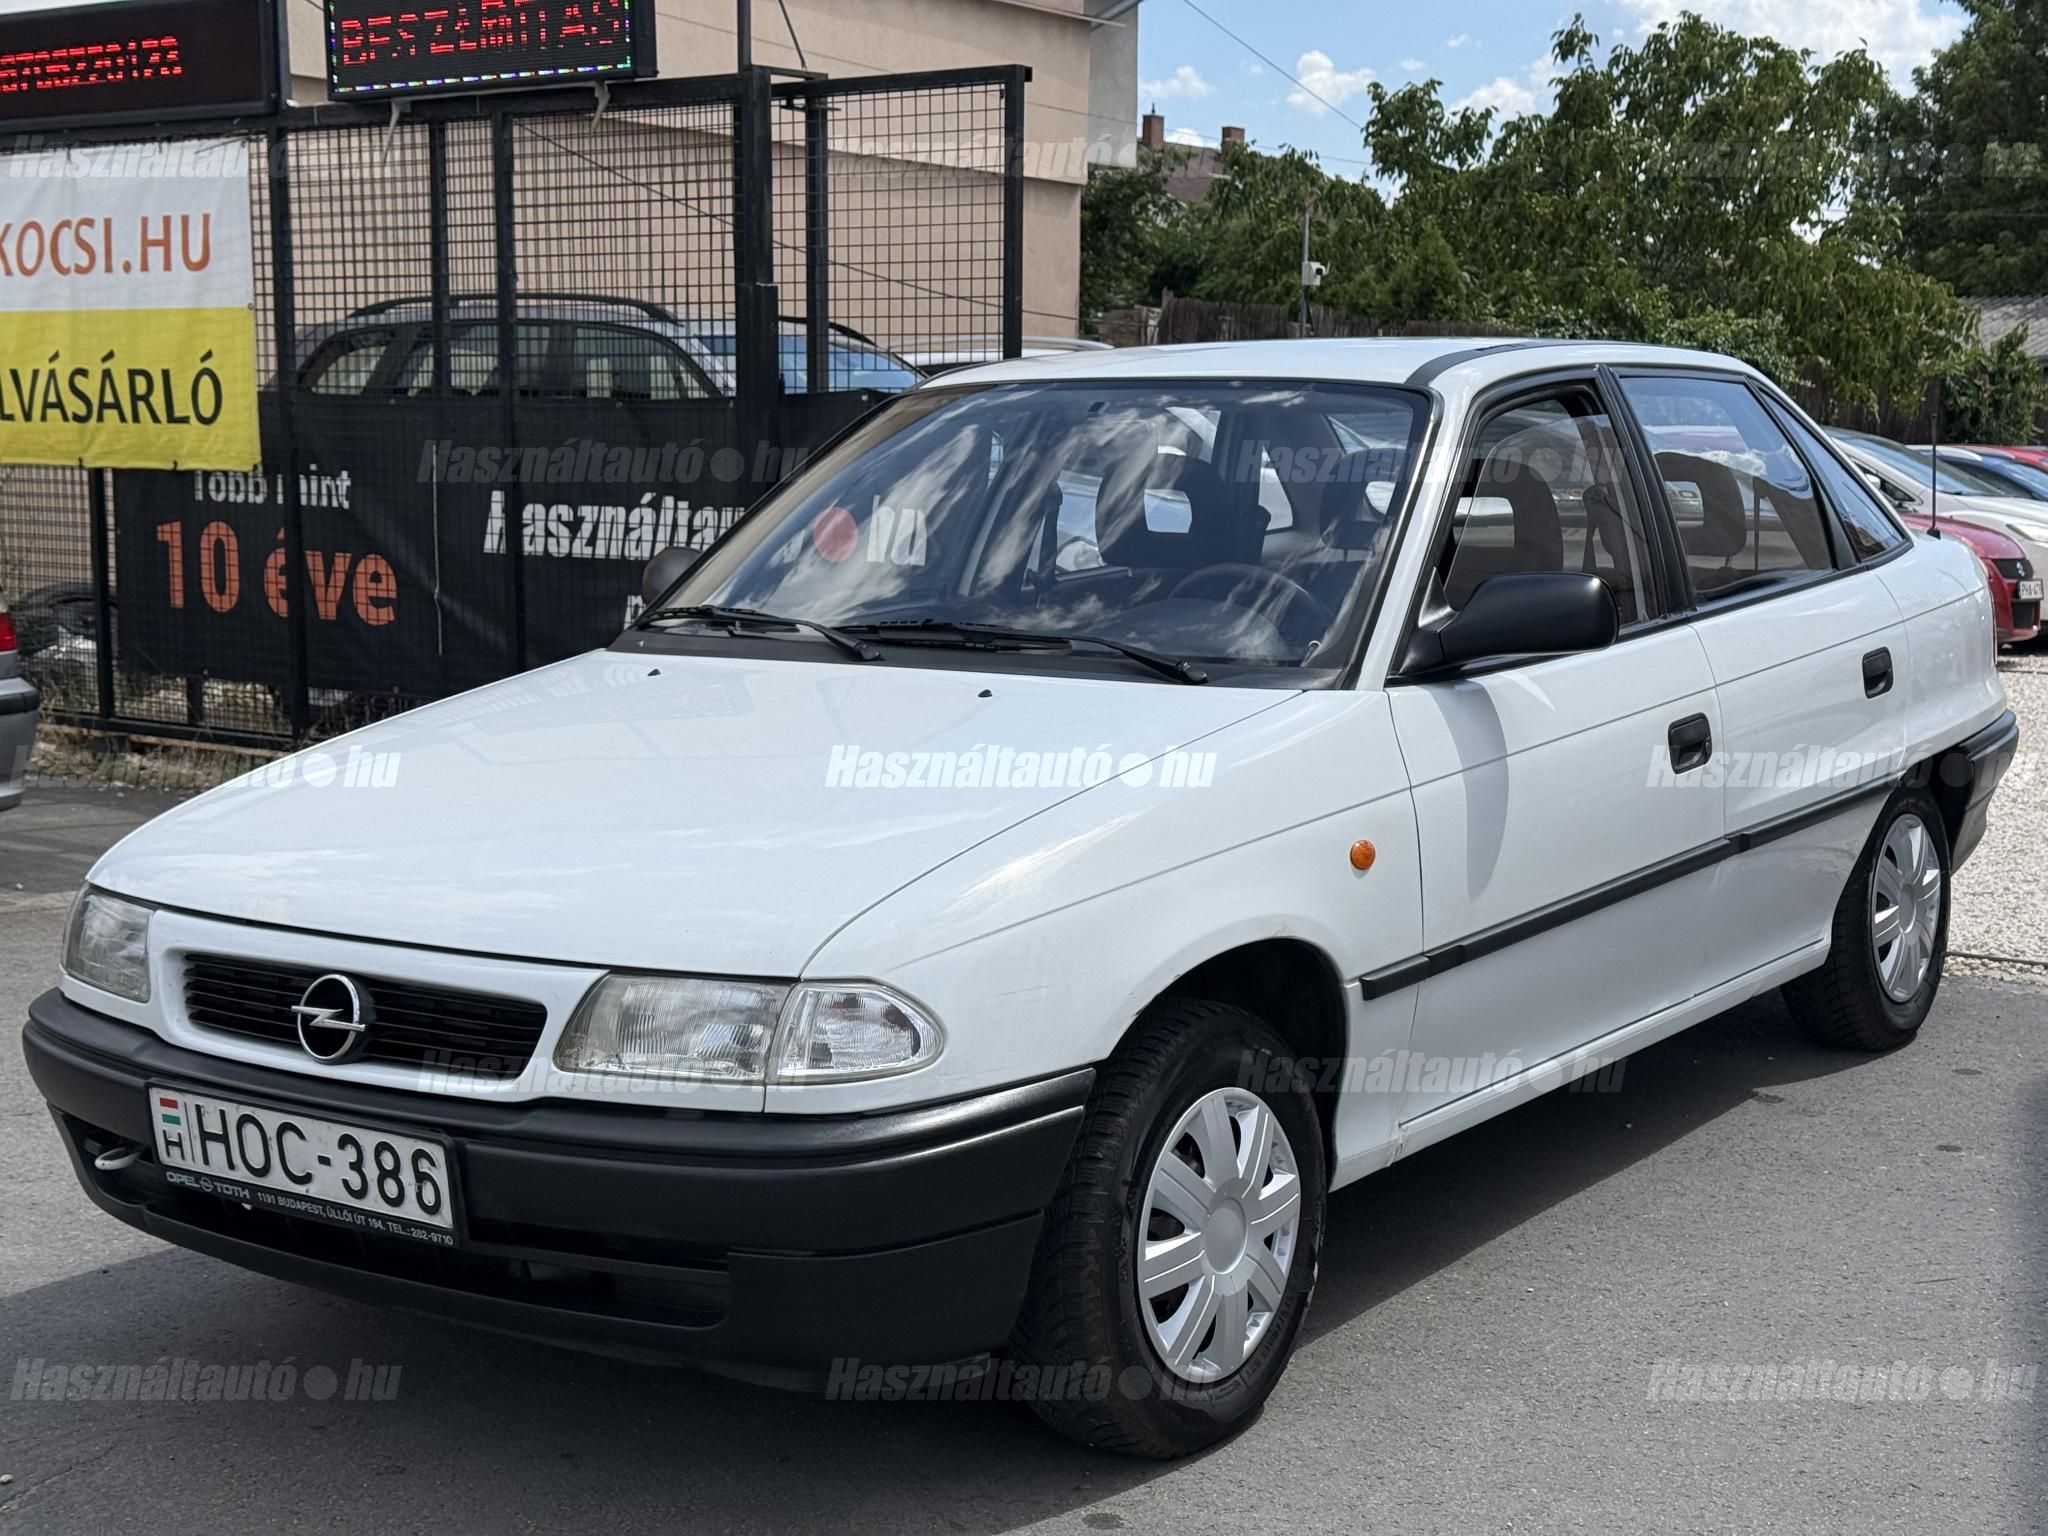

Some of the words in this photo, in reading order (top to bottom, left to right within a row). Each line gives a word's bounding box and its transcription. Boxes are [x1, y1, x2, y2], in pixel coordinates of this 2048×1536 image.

[156, 520, 240, 613] 10
[162, 1129, 185, 1161] H
[195, 1103, 442, 1216] HOC-386
[166, 1171, 201, 1189] OPEL
